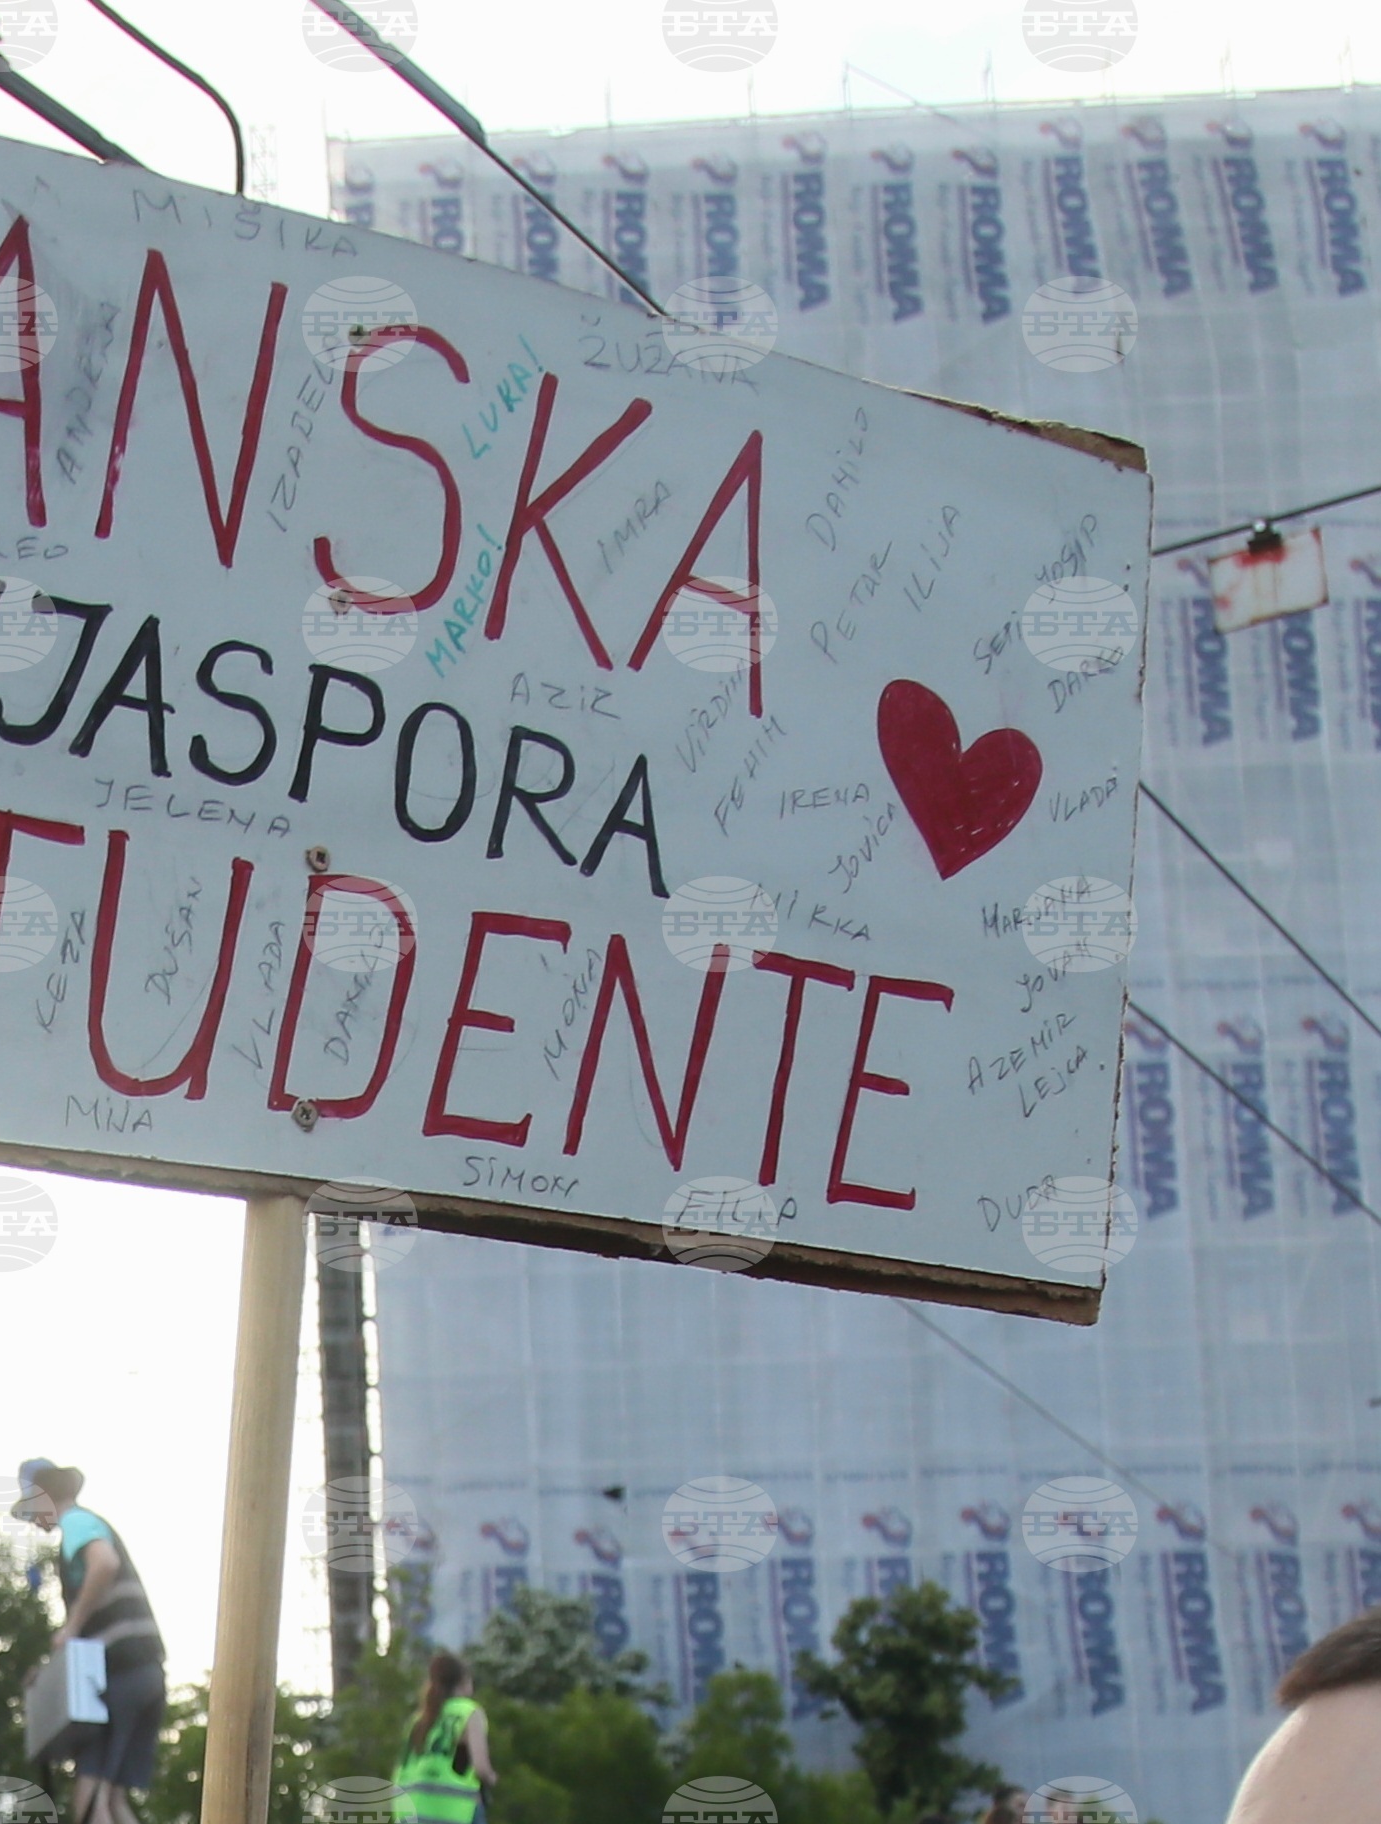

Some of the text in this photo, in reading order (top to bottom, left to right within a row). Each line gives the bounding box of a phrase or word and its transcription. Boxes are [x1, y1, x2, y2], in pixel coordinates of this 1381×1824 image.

[884, 183, 924, 321] ROMA
[971, 185, 1011, 324] ROMA
[1138, 160, 1192, 297] ROMA
[1224, 158, 1279, 294] ROMA
[1319, 159, 1366, 297] ROMA
